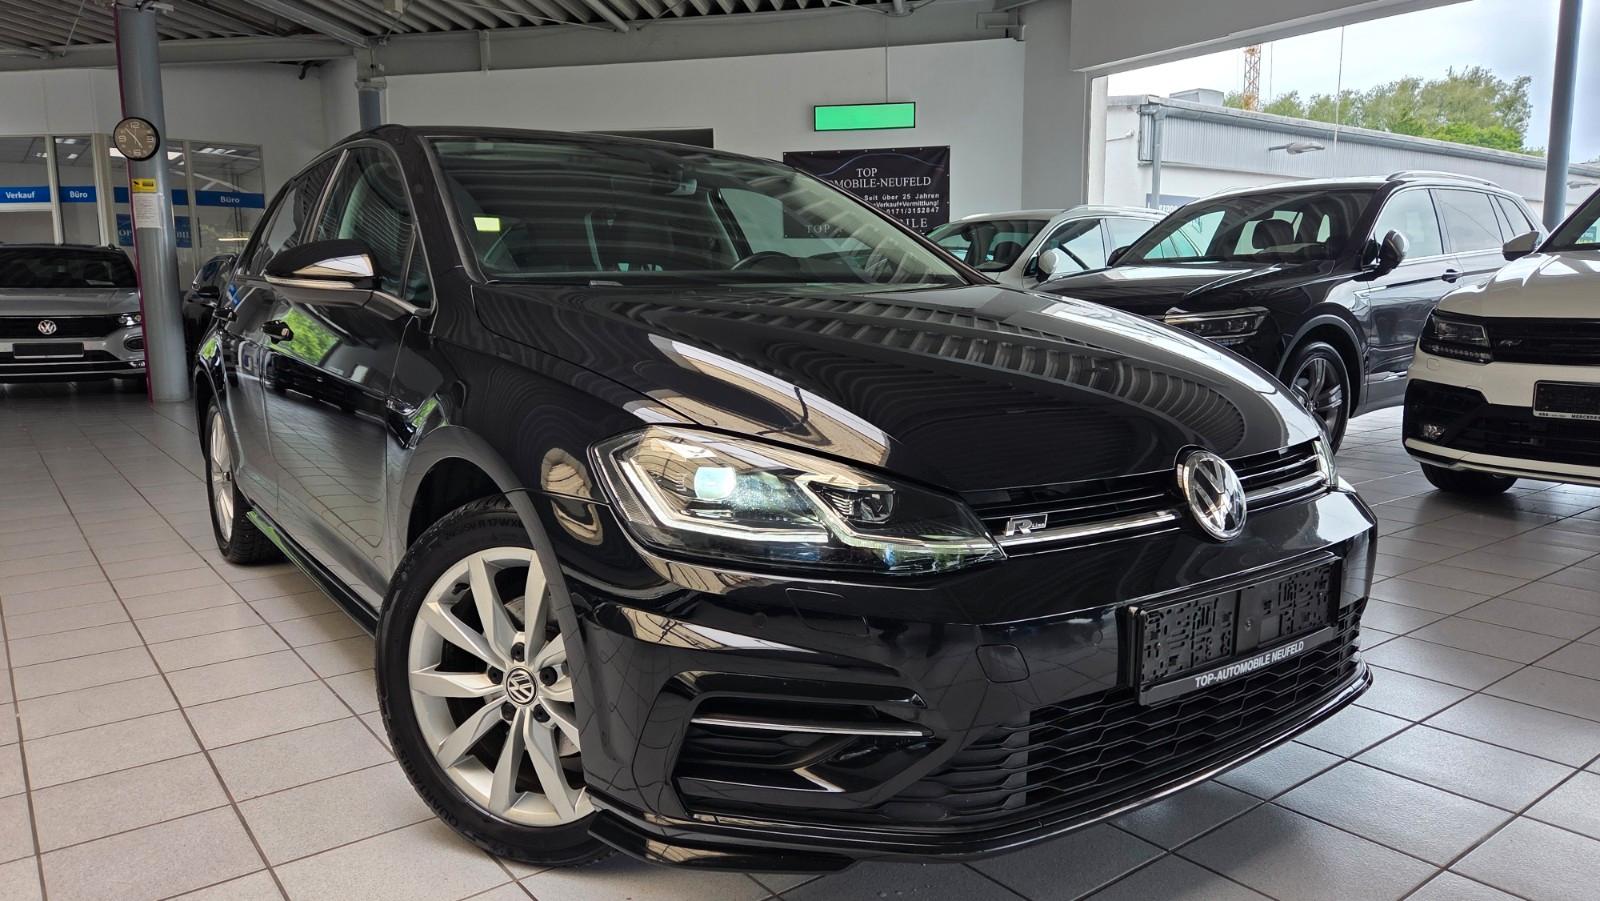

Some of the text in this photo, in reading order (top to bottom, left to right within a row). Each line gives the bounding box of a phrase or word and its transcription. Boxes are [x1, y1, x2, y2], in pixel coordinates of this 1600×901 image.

[131, 121, 140, 129] 12
[856, 167, 878, 178] TOP
[5, 190, 36, 199] Verkauf
[69, 190, 88, 198] Büro
[882, 193, 898, 201] über
[220, 195, 240, 204] Büro
[1195, 641, 1304, 688] TOP-AUTOMOBILE NEUFELD
